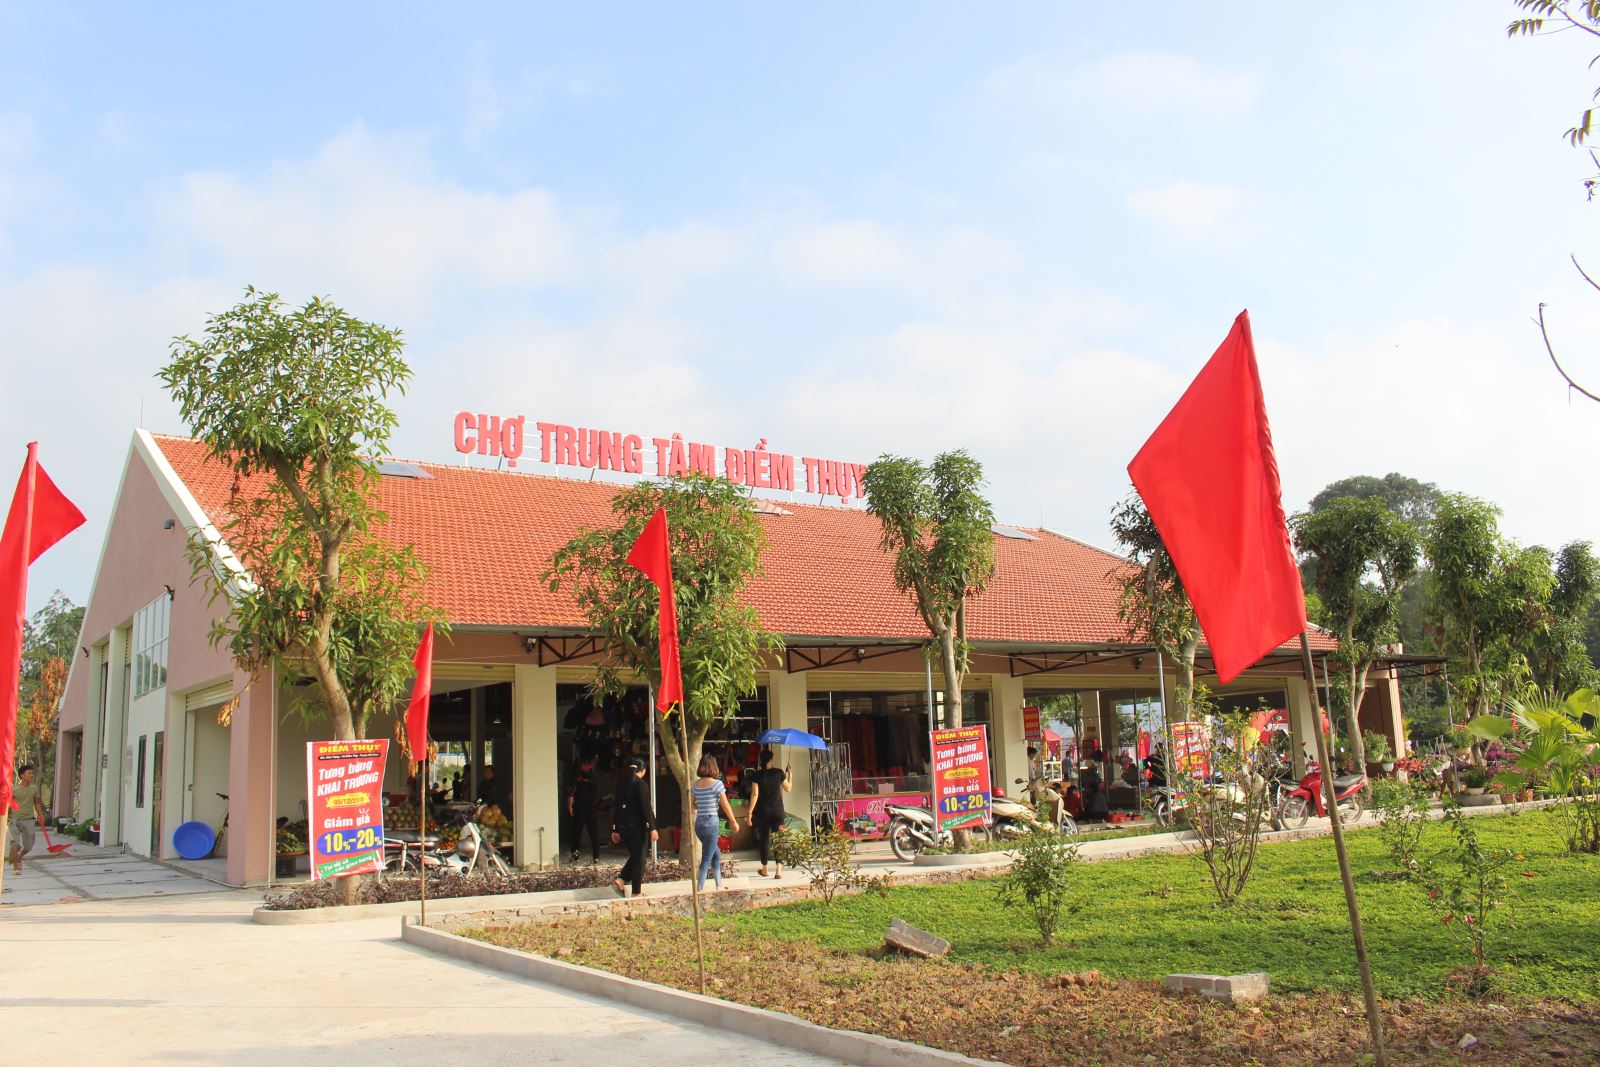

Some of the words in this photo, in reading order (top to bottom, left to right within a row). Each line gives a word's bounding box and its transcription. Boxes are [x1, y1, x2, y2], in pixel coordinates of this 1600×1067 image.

[454, 411, 525, 467] CHỢ
[536, 421, 643, 474] TRUNG
[653, 432, 716, 478] TÂM
[802, 456, 868, 504] THỤY
[319, 766, 345, 780] Tưng
[936, 760, 953, 771] KHAI
[317, 781, 341, 796] KHAI
[324, 816, 354, 829] Giảm
[356, 814, 370, 827] giá
